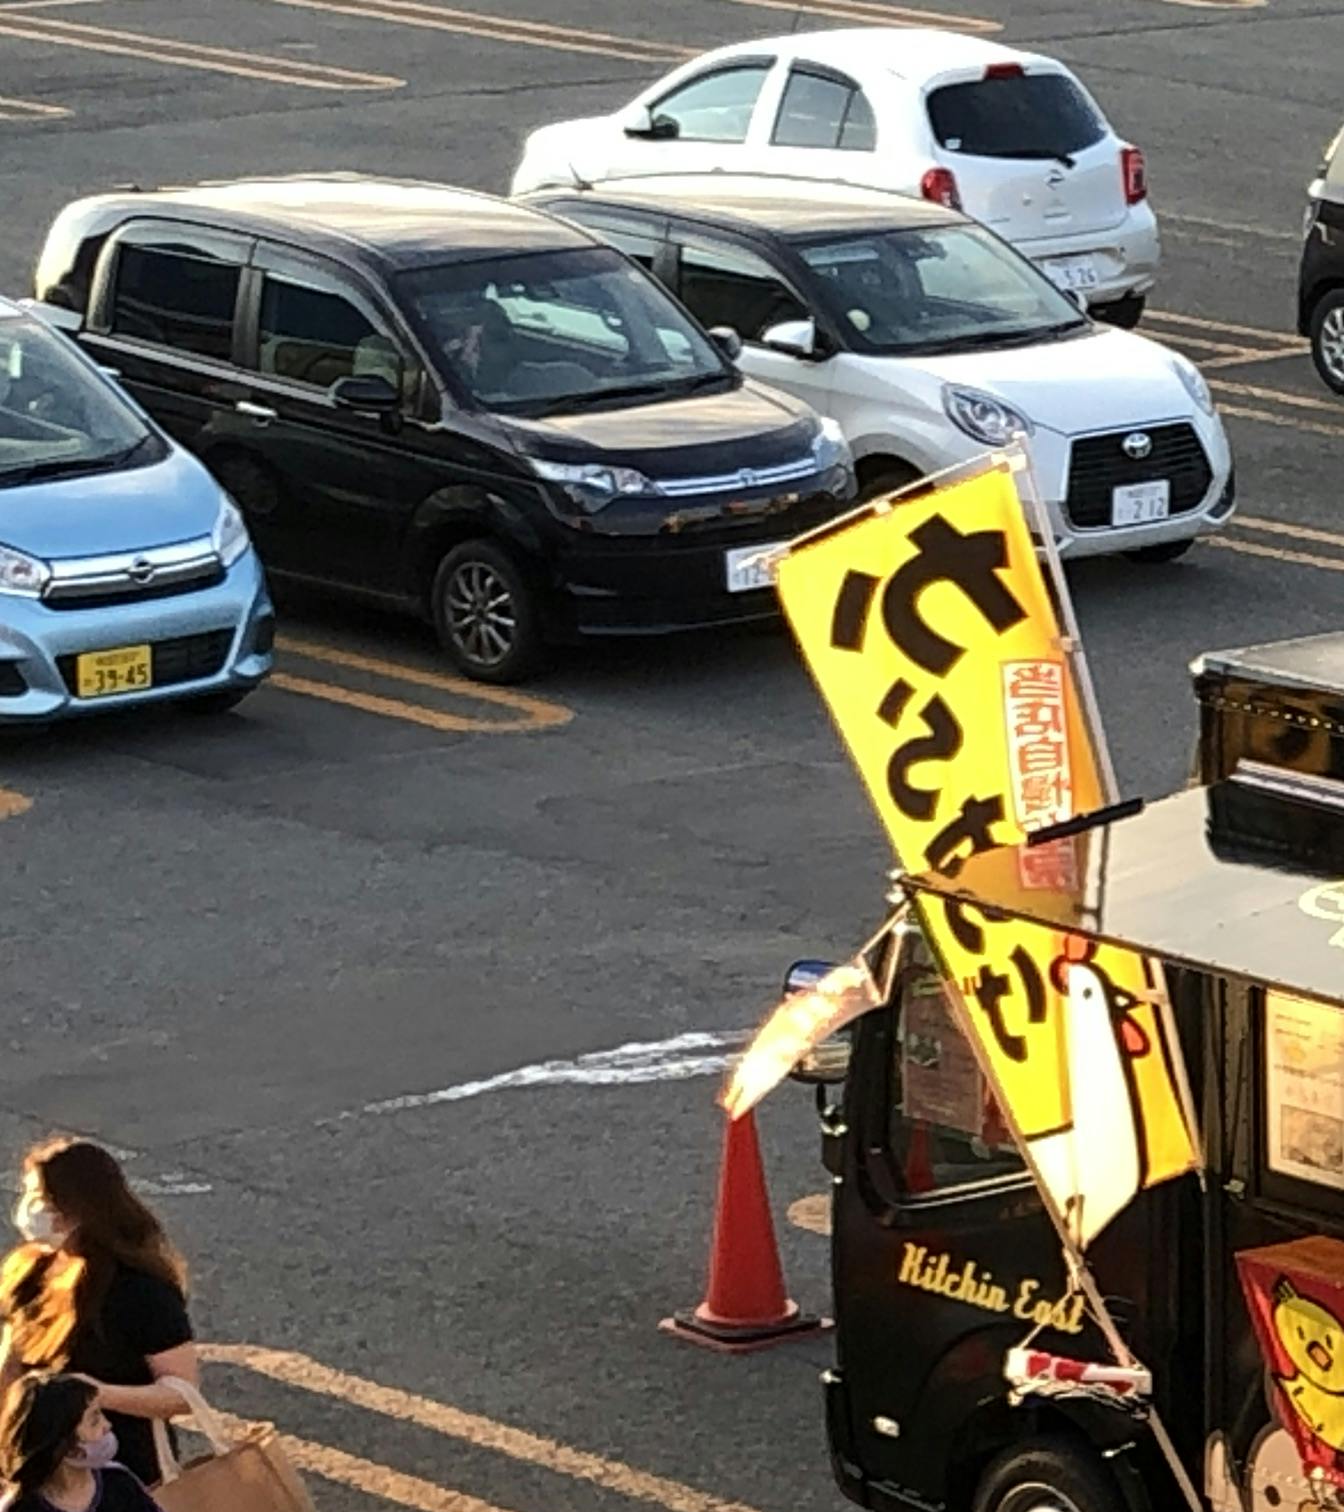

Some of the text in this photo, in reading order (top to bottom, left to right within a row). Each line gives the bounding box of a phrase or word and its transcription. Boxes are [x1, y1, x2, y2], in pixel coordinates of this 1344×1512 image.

[95, 663, 148, 695] 39-45
[898, 1242, 1085, 1335] Kitchin East
